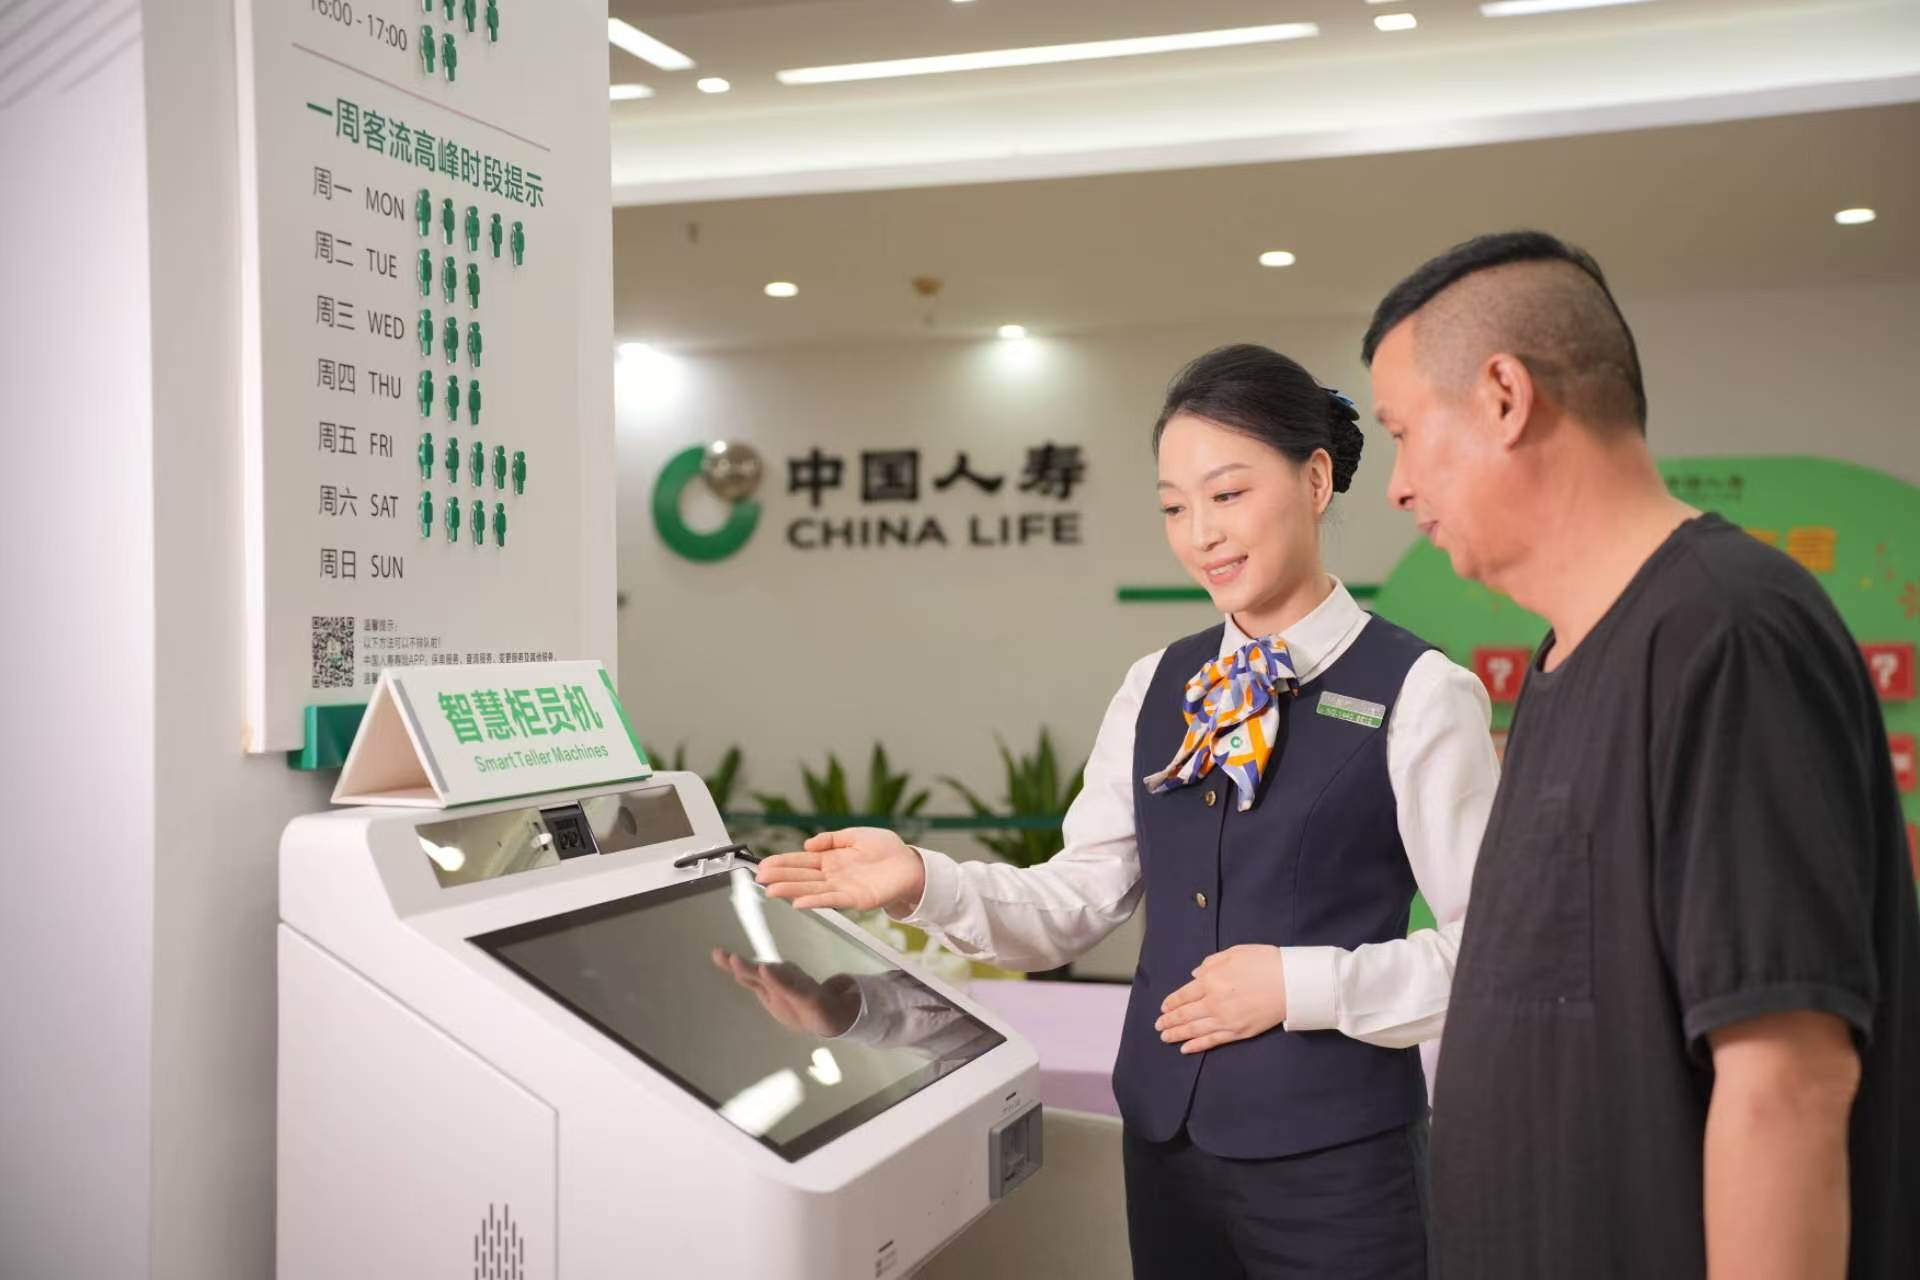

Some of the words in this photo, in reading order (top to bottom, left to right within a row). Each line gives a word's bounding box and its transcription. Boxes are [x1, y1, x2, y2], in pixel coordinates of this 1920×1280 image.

[367, 13, 408, 52] 17:00
[306, 97, 544, 209] 一周客流高峰时段提示
[313, 165, 353, 201] 周一
[366, 187, 405, 222] MON
[314, 229, 354, 267] 周二
[366, 248, 398, 279] TUE
[316, 295, 355, 331] 周三
[368, 309, 405, 341] WED
[316, 357, 356, 394] 周四
[368, 370, 401, 400] THU
[318, 421, 357, 456] 周五
[369, 432, 393, 458] FRI
[787, 440, 1087, 507] 中国人寿
[319, 484, 358, 517] 周六
[370, 493, 399, 520] SAT
[786, 514, 948, 549] CHINA
[969, 511, 1083, 546] LIFE
[319, 547, 357, 580] 周日
[370, 554, 404, 580] SUN
[437, 684, 604, 745] 智慧柜员机
[474, 755, 517, 773] Smart
[515, 751, 552, 767] Teller
[552, 743, 609, 763] Machines
